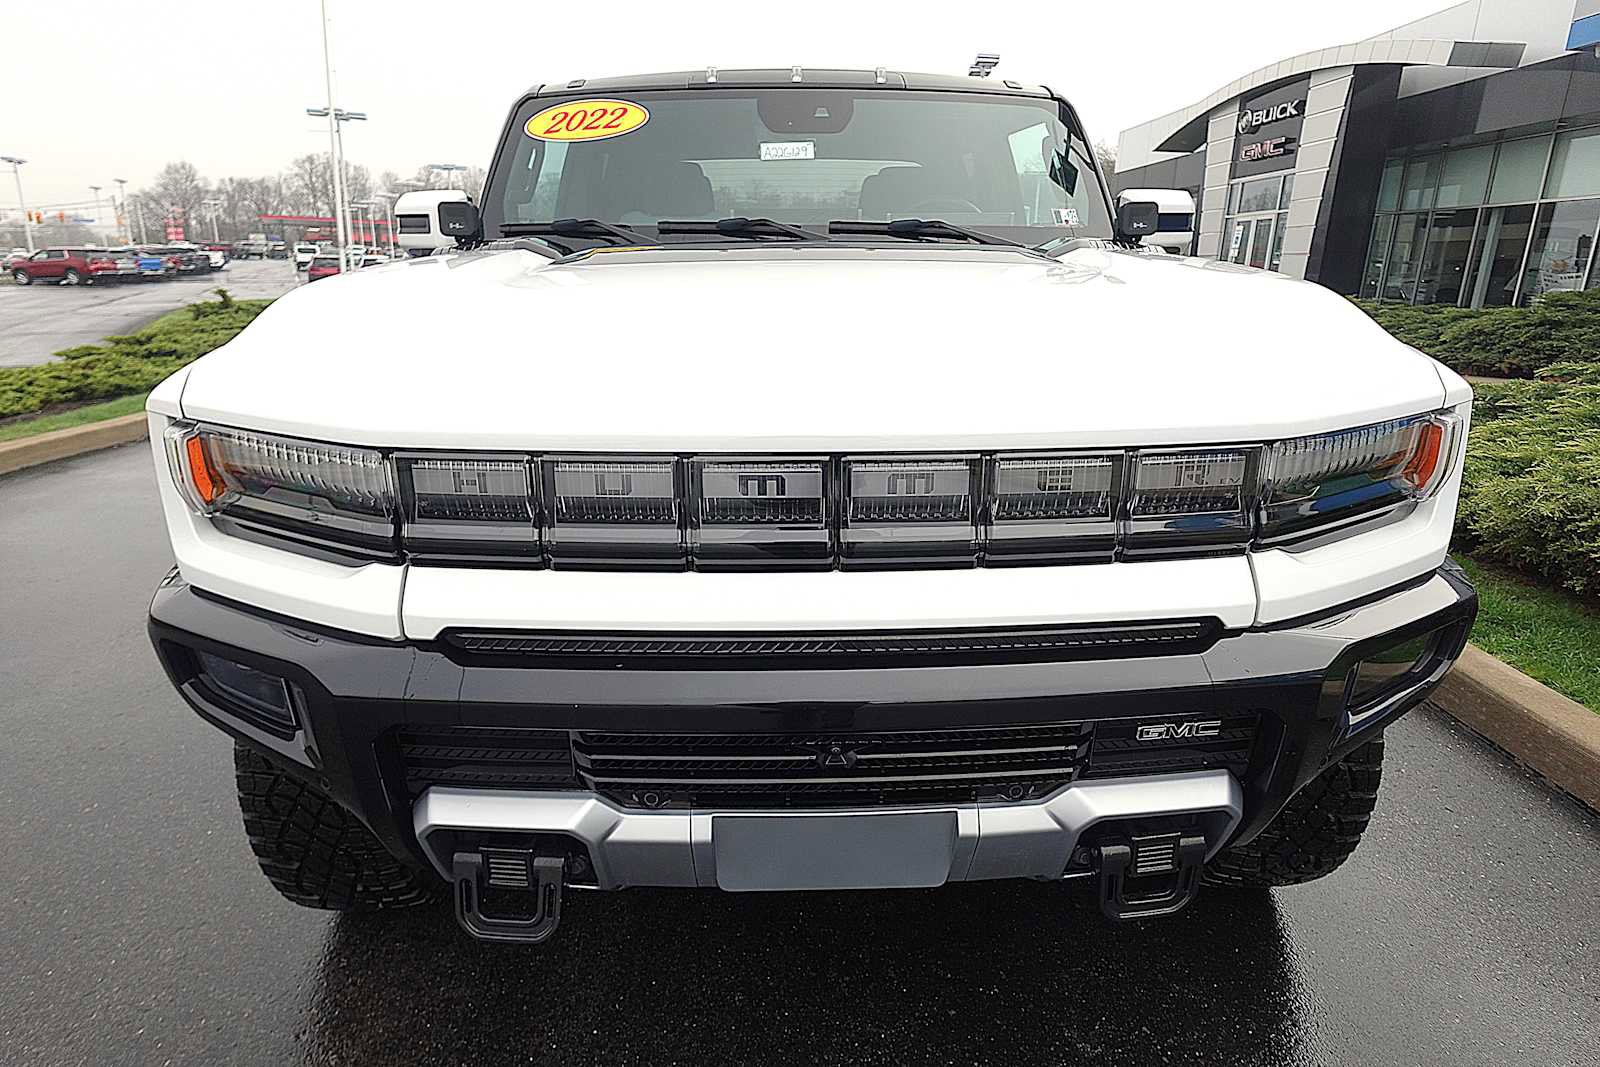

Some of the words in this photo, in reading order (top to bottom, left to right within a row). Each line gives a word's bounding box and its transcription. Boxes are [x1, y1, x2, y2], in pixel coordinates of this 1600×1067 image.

[543, 107, 628, 135] 2022
[1252, 100, 1299, 126] BUICK
[1241, 137, 1286, 160] GMC
[1136, 720, 1221, 741] GMC
